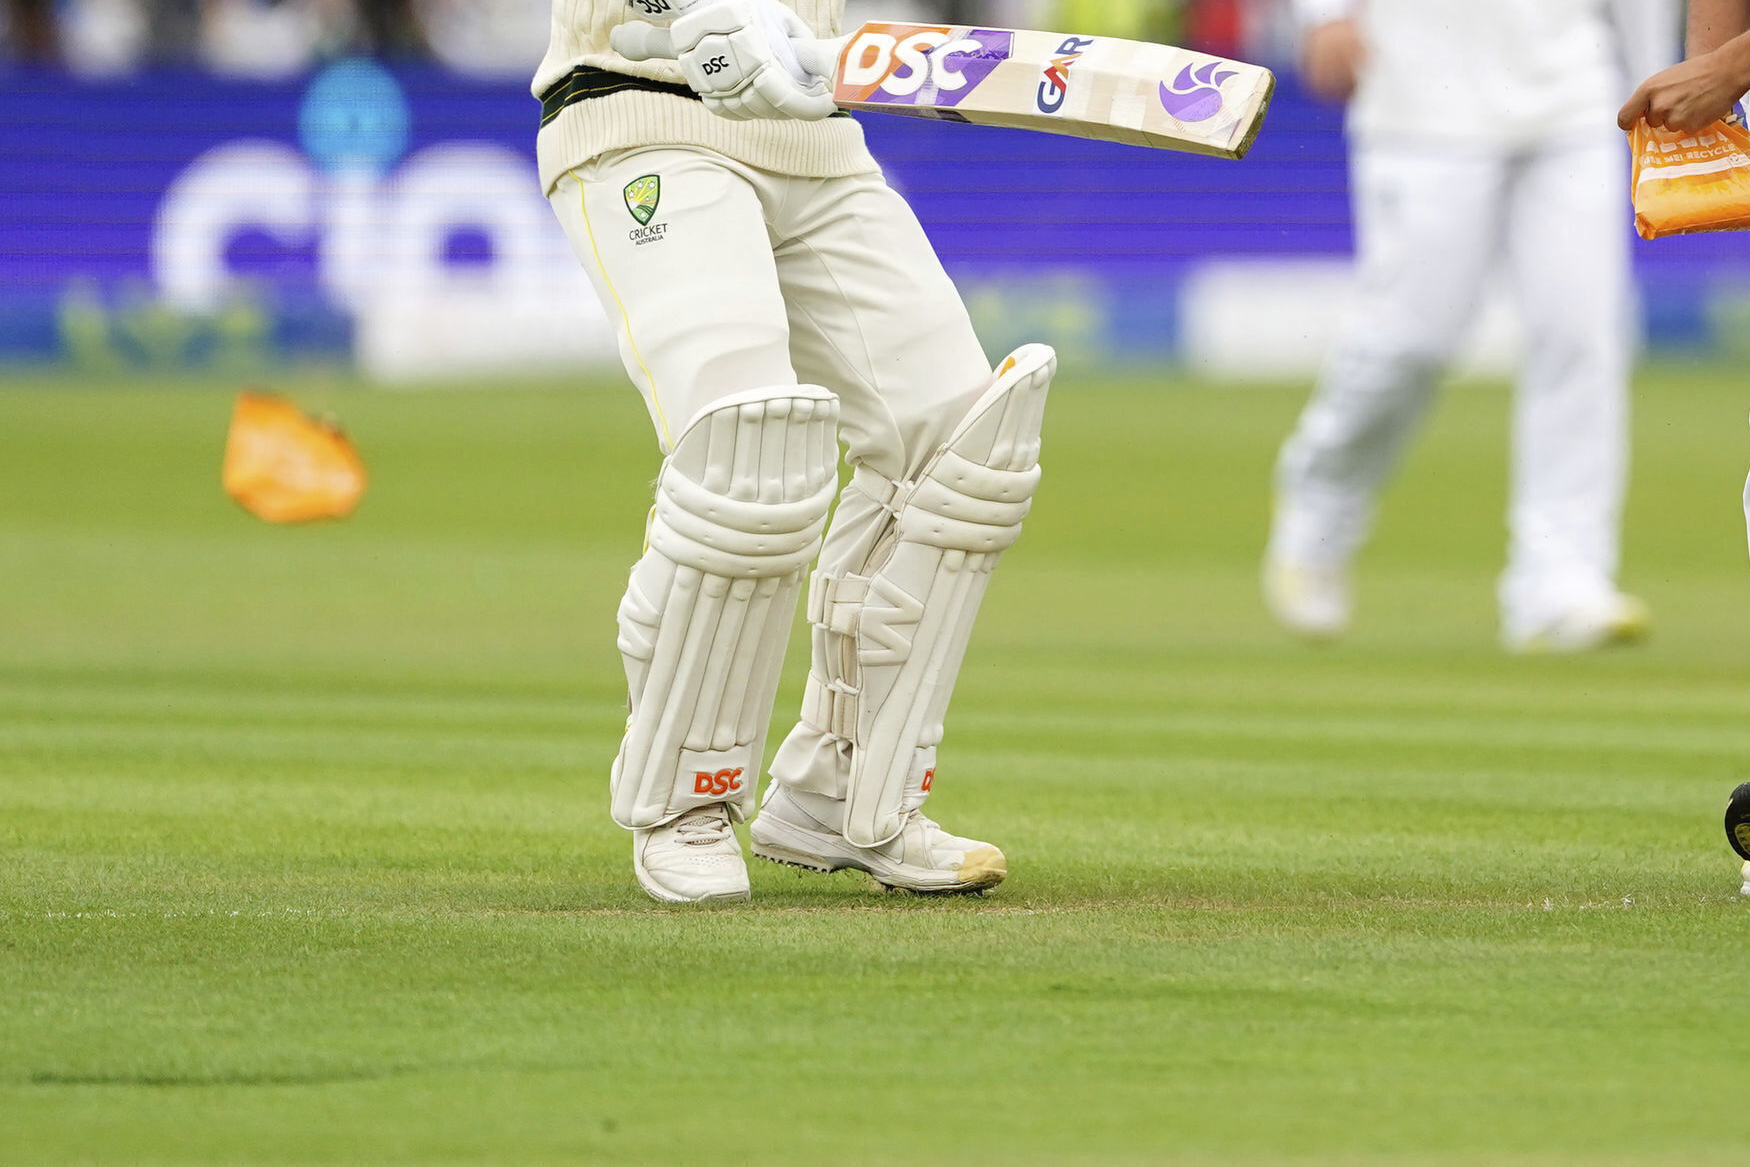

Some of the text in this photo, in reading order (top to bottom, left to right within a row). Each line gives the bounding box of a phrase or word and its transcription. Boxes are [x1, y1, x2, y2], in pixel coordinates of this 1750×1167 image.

[702, 55, 730, 76] DSC
[842, 31, 984, 96] DSC
[1686, 144, 1736, 160] RECYCLE
[629, 223, 668, 241] CRICKET
[635, 235, 664, 245] AUSTRALIA
[694, 768, 743, 796] DSC
